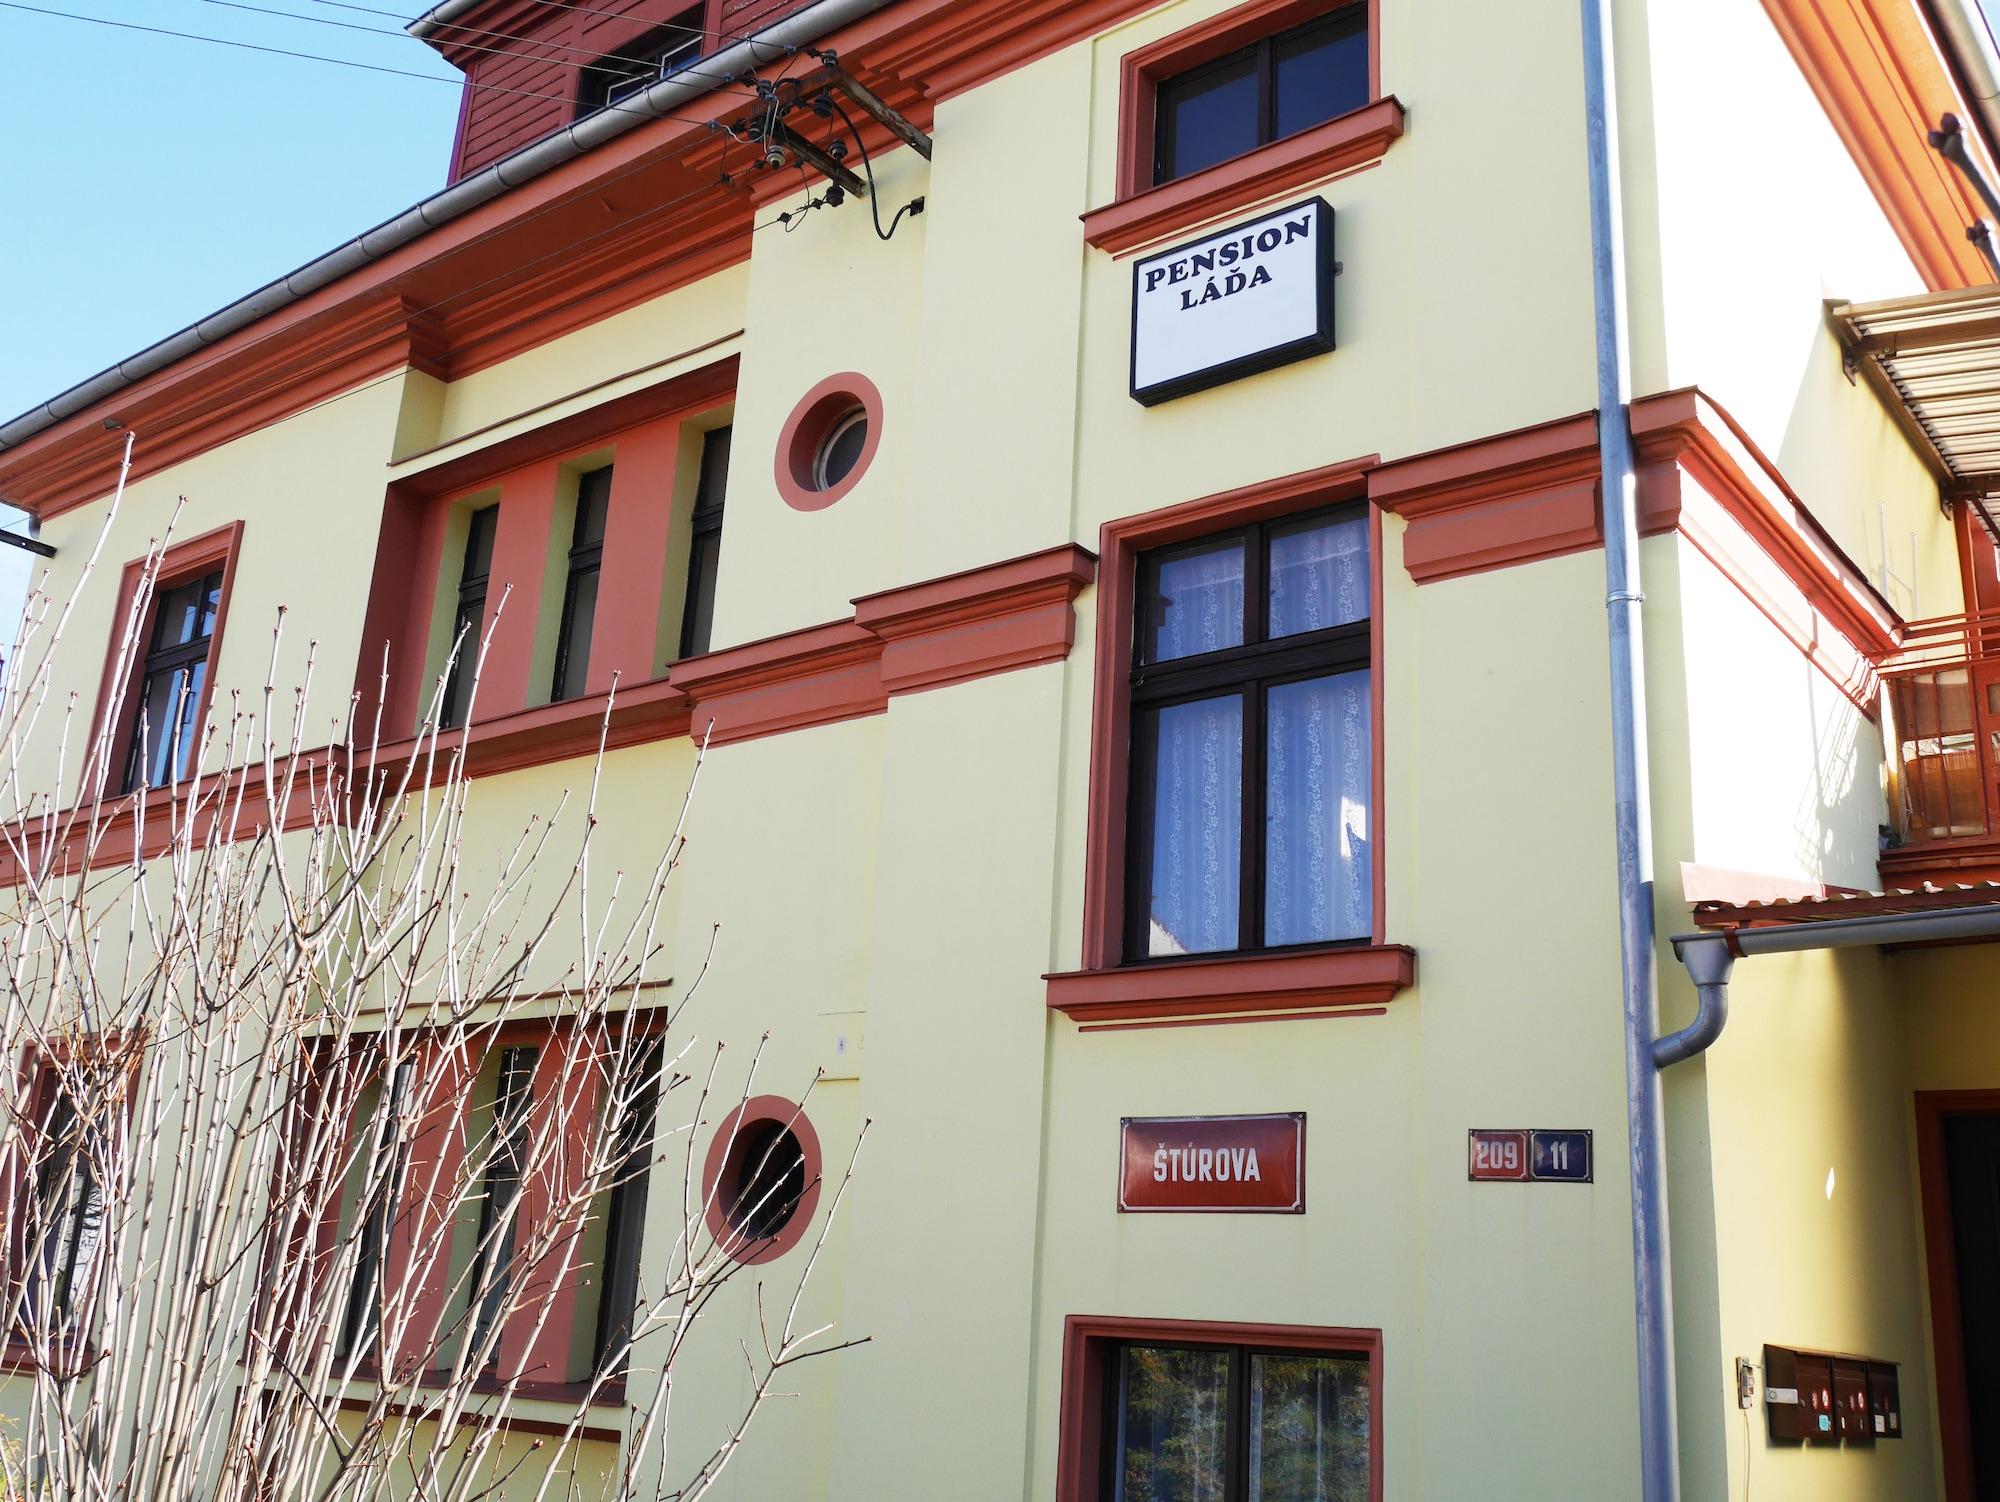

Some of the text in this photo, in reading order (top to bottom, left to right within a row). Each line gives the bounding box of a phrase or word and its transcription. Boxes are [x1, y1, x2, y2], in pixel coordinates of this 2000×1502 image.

[1145, 215, 1311, 292] PENSION
[1181, 265, 1272, 311] LÁĎA
[1153, 1142, 1261, 1182] ŠTÚROVA
[1477, 1141, 1518, 1169] 209
[1550, 1141, 1568, 1170] 11
